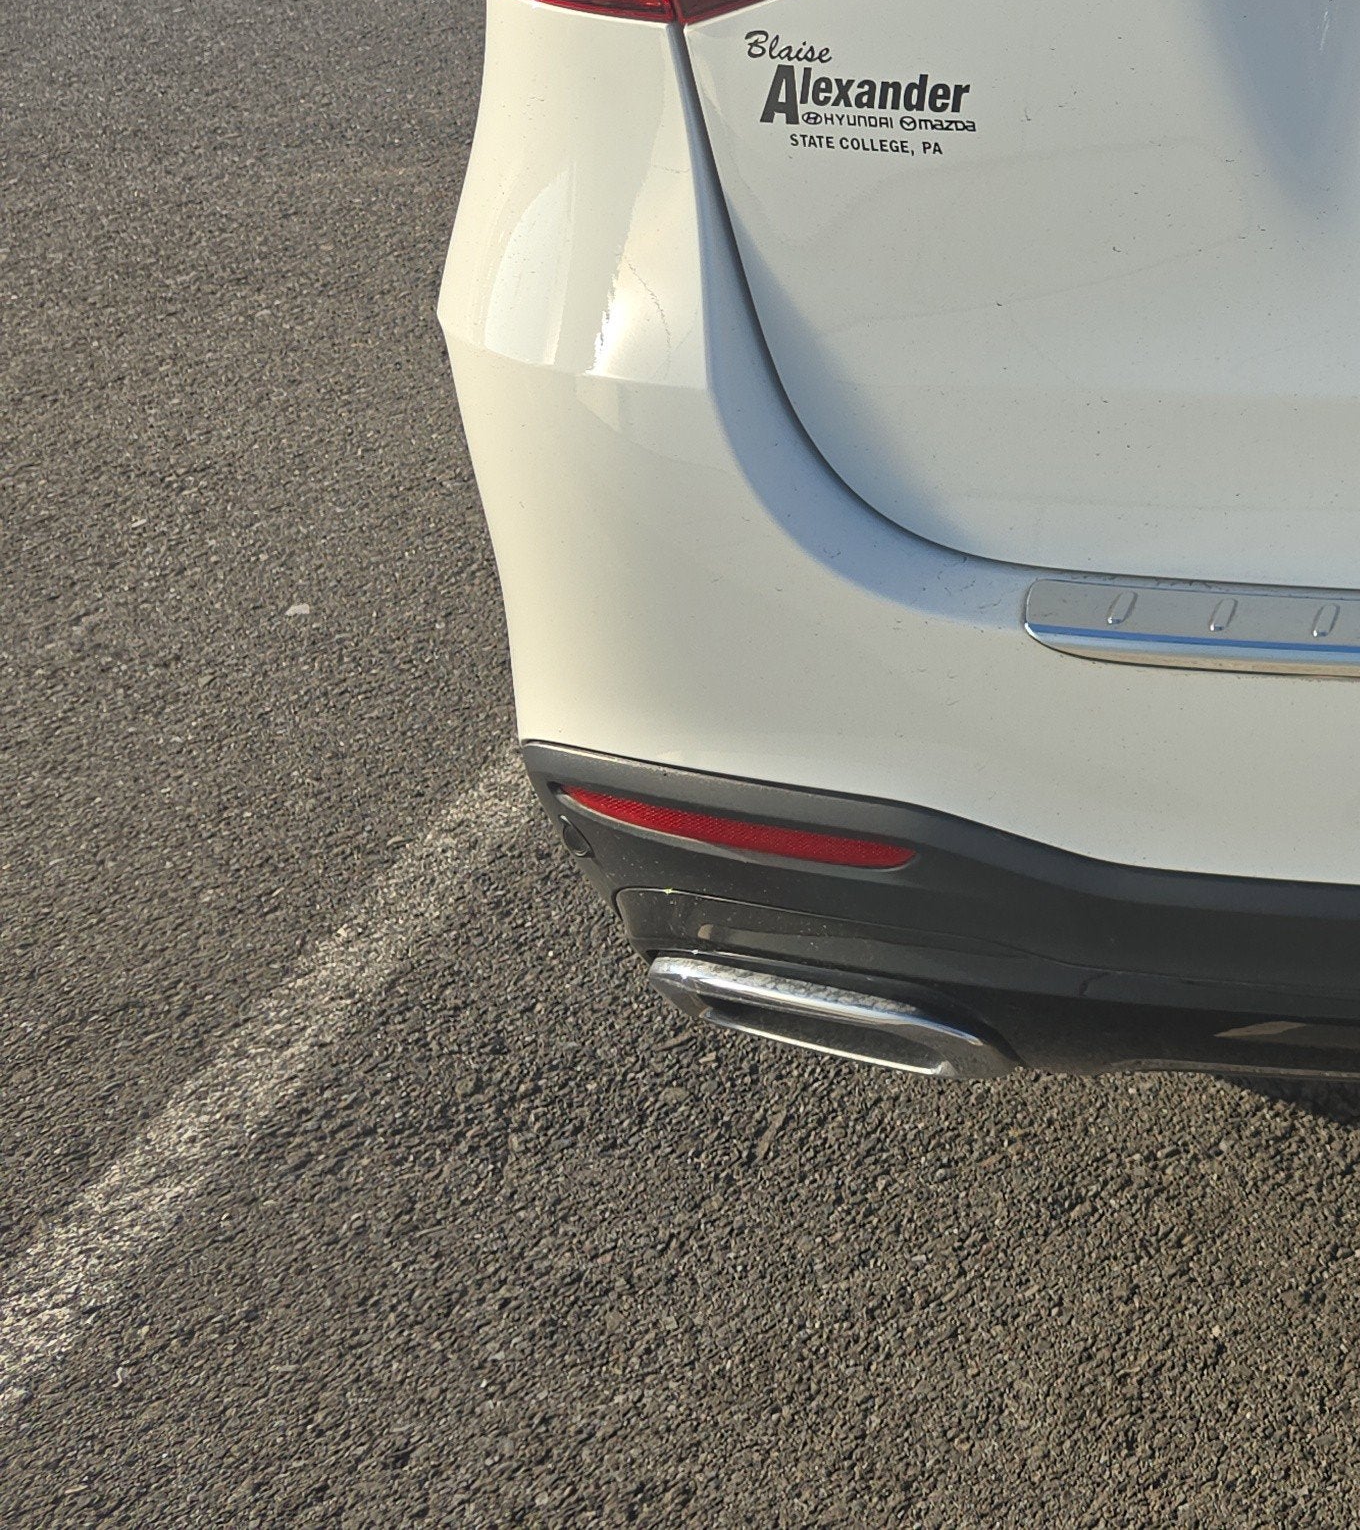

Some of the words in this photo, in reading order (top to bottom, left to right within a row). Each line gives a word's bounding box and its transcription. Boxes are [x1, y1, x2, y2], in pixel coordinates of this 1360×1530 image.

[744, 29, 833, 64] Blaise
[759, 63, 971, 126] Alexander
[823, 112, 894, 129] HYUNDAI
[789, 133, 836, 150] STATE
[839, 136, 916, 157] COLLEGE,
[922, 141, 944, 156] PA
